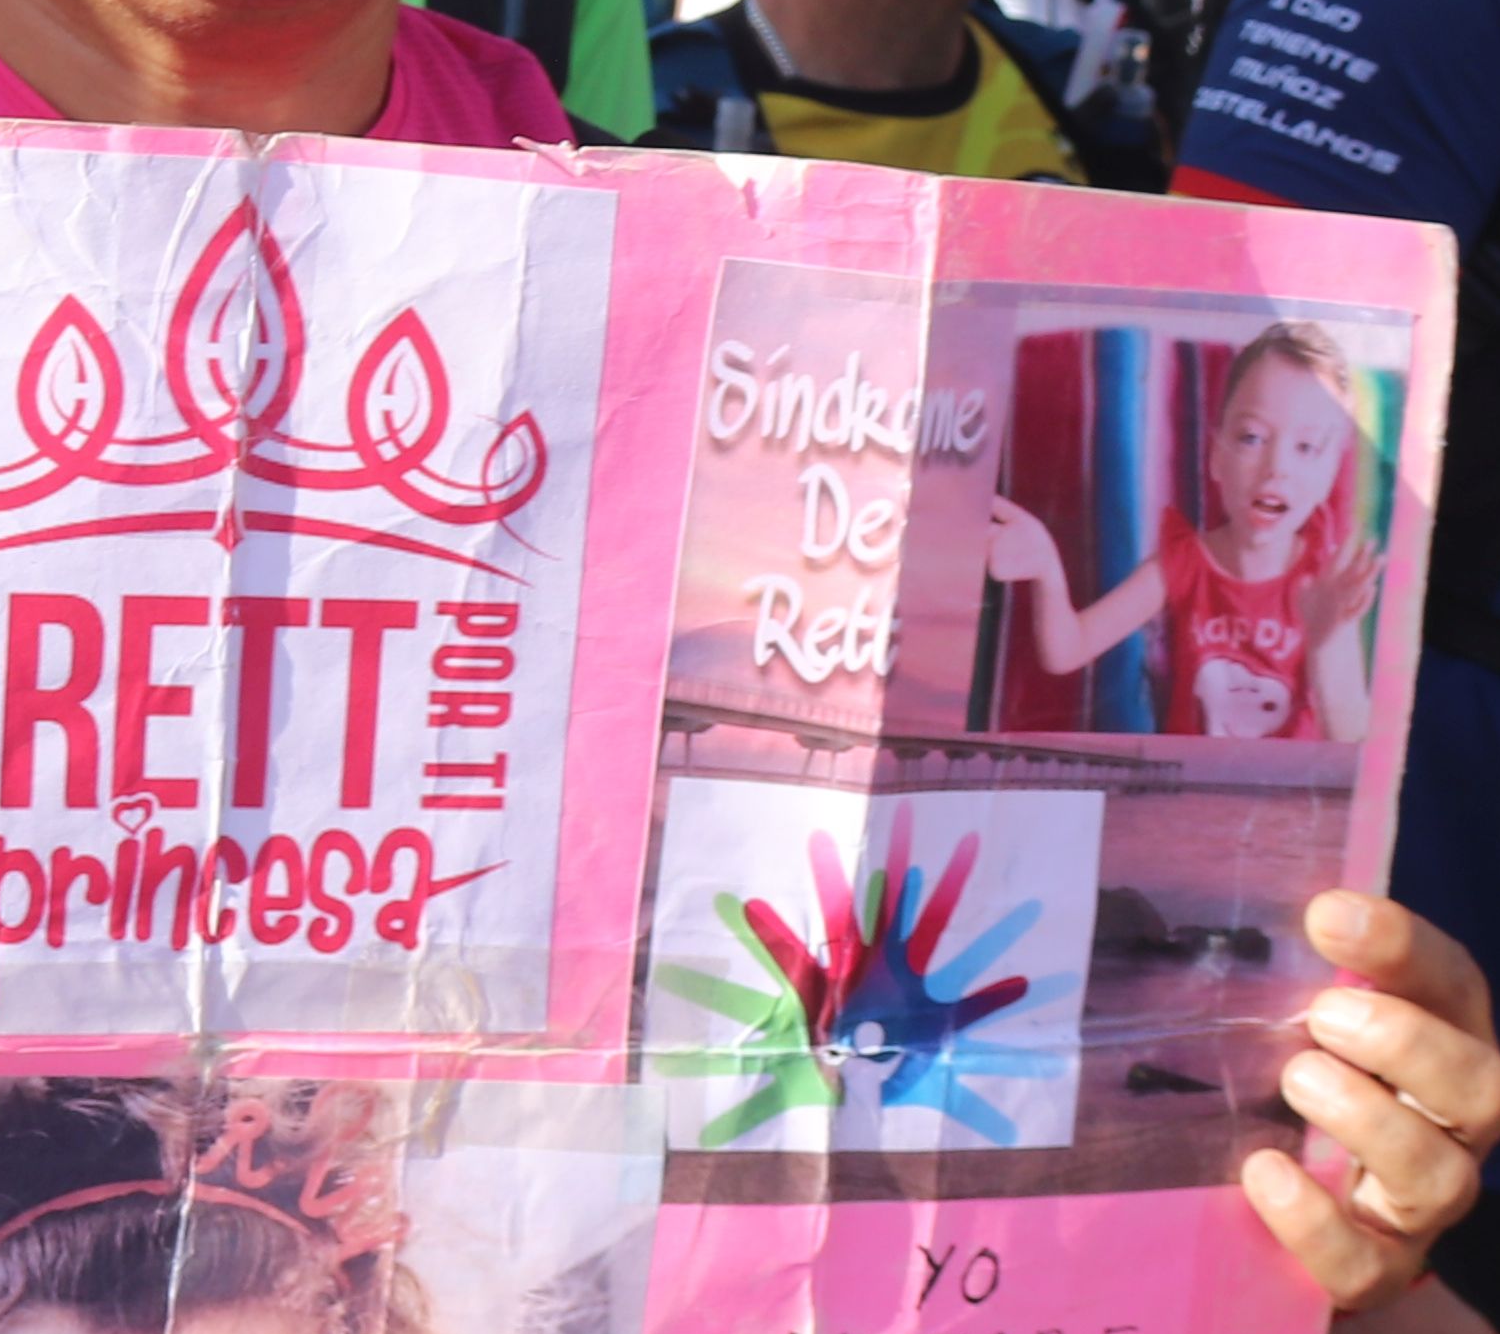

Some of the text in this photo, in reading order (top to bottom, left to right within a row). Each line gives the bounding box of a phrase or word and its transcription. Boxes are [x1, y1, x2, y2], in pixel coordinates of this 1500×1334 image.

[1238, 18, 1380, 84] TENIENTE
[707, 339, 990, 456] Síndrome
[797, 462, 906, 563] De
[744, 573, 902, 685] Rett
[0, 592, 419, 810] RETT
[420, 601, 520, 811] POR TI
[916, 1244, 1001, 1311] YO
